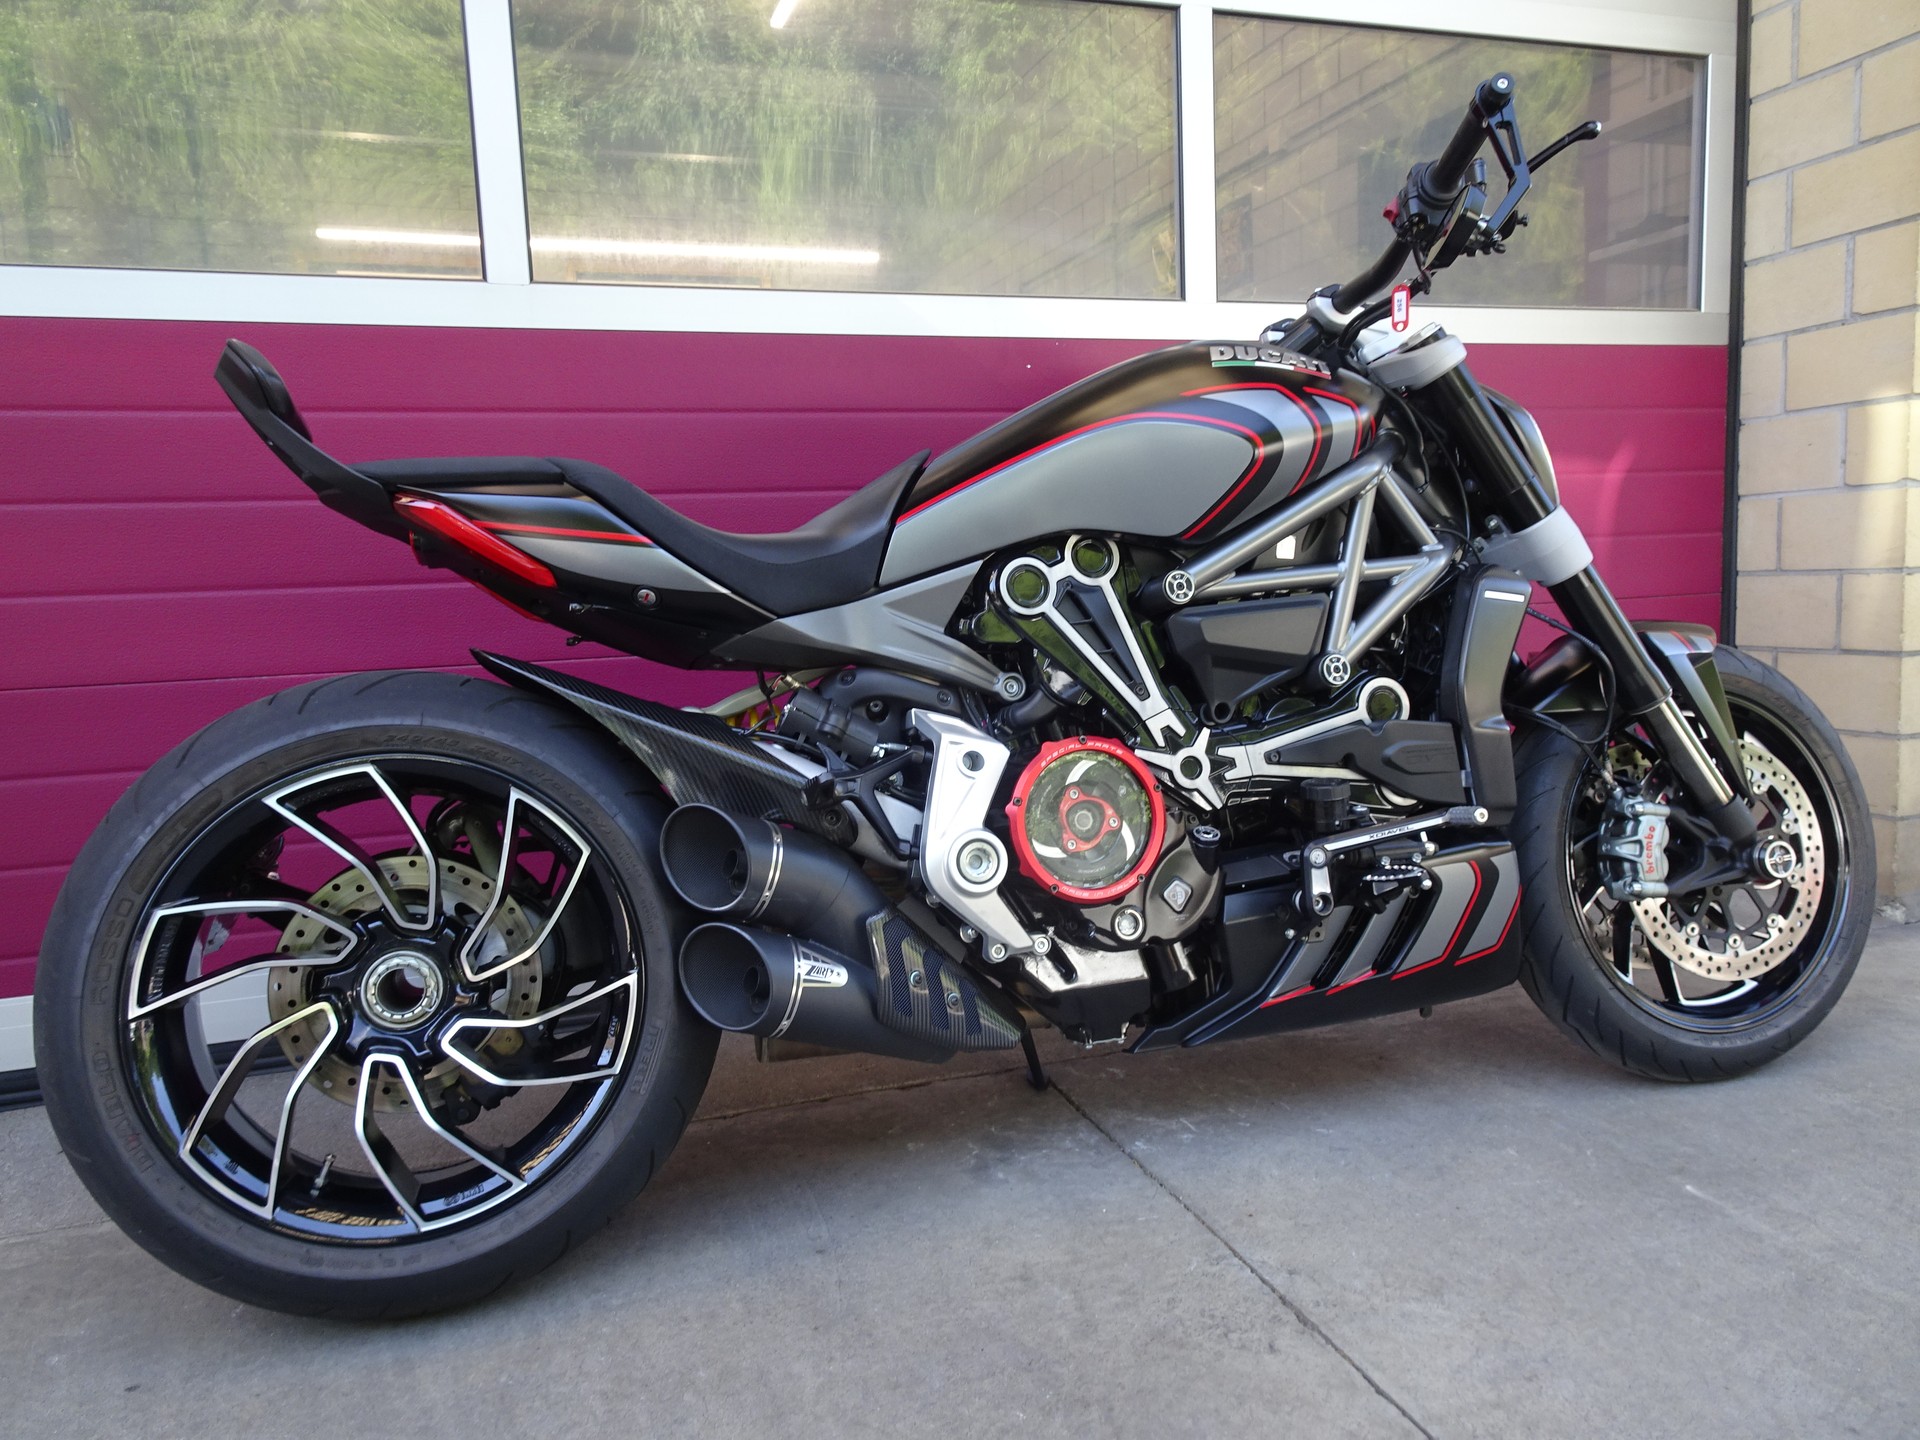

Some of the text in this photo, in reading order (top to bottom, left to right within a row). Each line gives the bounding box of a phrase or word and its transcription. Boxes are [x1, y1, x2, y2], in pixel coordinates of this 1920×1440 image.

[1209, 345, 1331, 375] DUCATI
[1040, 742, 1124, 768] SPECIAL PARTS
[1369, 826, 1414, 840] XDIAVEL
[1644, 825, 1656, 874] brembo
[92, 898, 135, 1005] ROSSO
[92, 1050, 155, 1174] DIABLO
